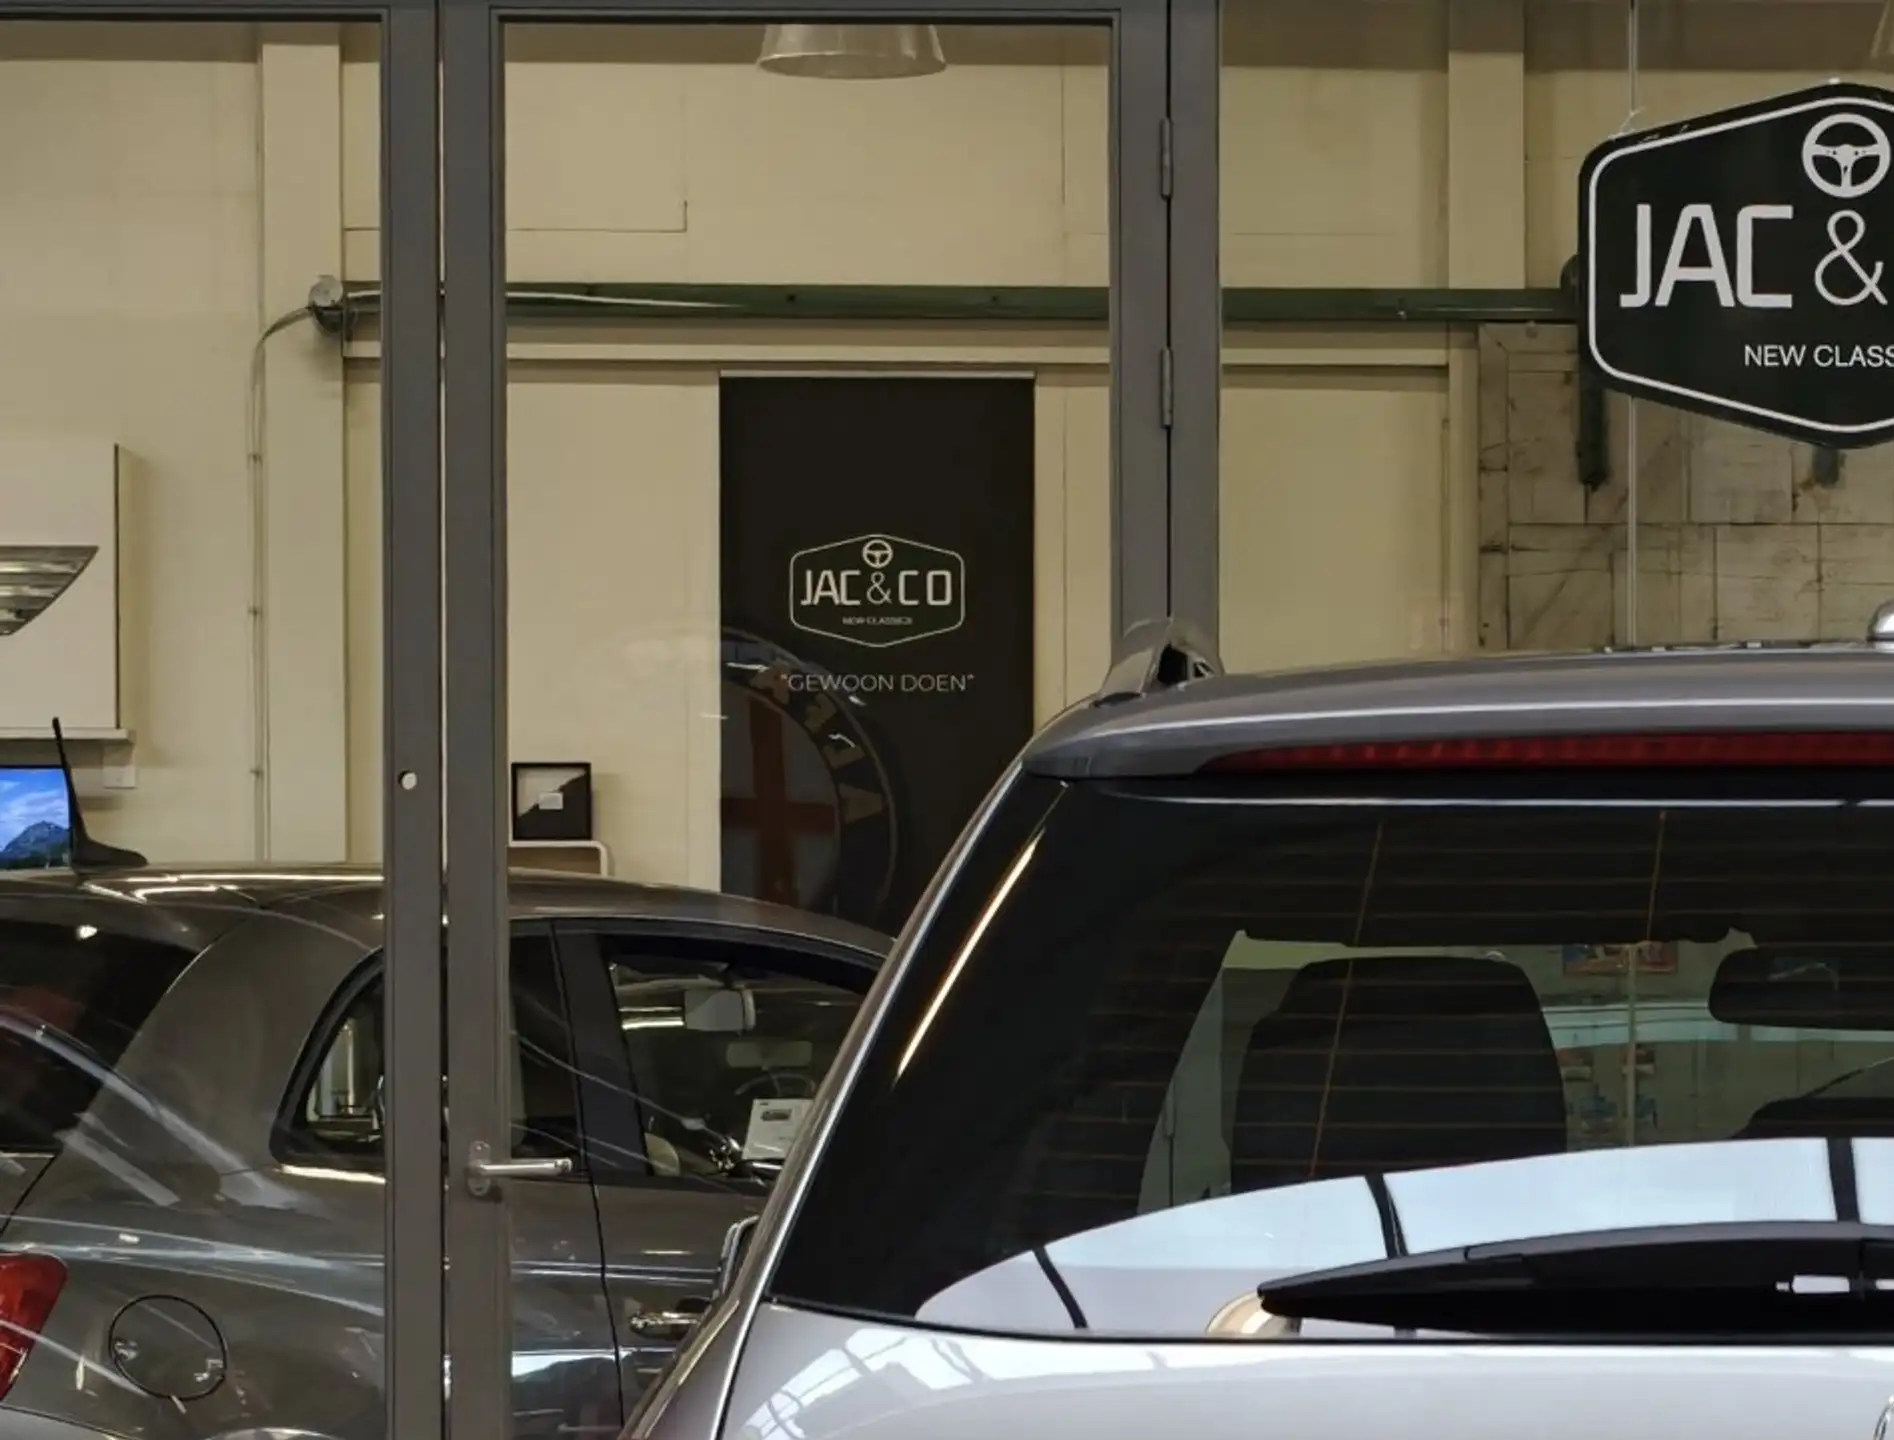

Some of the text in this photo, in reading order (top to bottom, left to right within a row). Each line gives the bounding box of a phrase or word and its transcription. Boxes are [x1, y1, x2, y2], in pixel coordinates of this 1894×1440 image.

[1620, 204, 1793, 307] JAC
[1814, 209, 1888, 305] &
[1744, 344, 1805, 368] NEW
[800, 569, 861, 606] JAC
[866, 571, 893, 604] &
